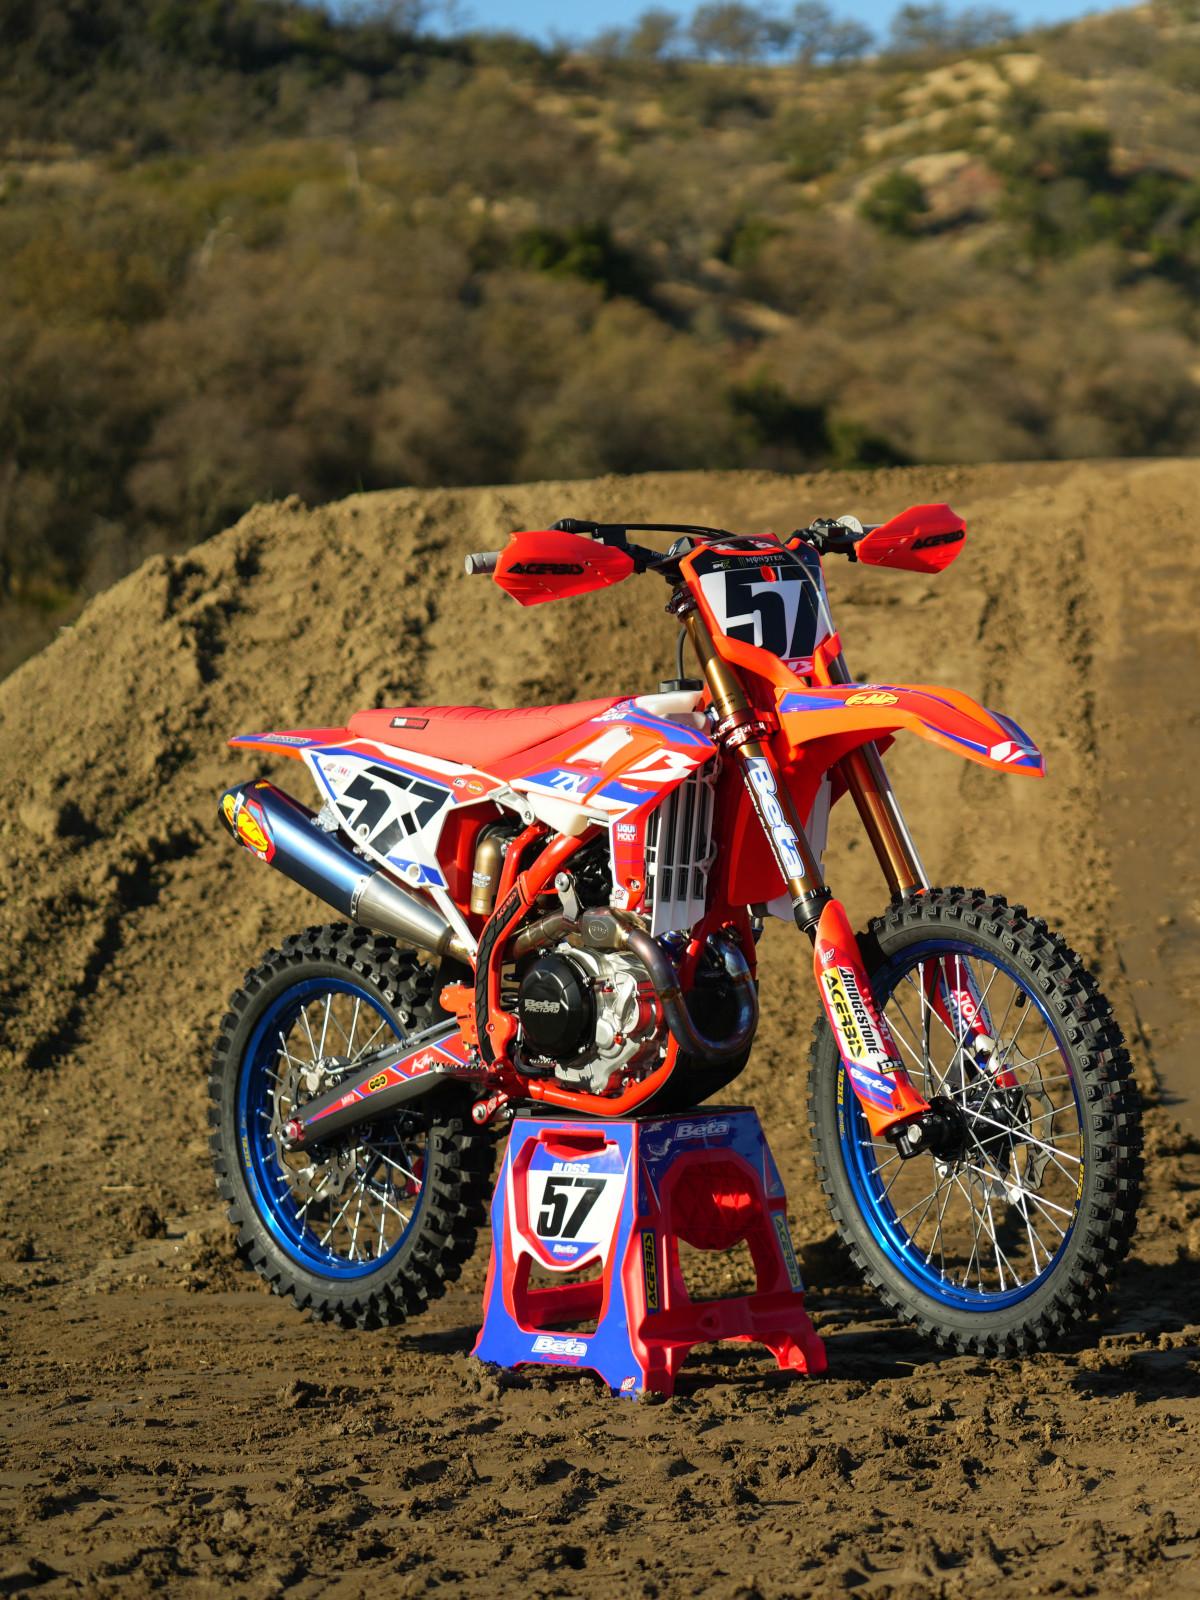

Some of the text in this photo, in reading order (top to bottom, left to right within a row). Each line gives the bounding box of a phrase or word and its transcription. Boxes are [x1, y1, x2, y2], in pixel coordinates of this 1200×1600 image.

[910, 528, 966, 552] ACERBIS
[505, 562, 586, 577] ACERBIS
[745, 554, 786, 564] MONSTER
[724, 565, 822, 660] 57
[844, 691, 899, 707] FMF
[335, 764, 454, 858] 57
[743, 757, 805, 879] Beta
[616, 824, 637, 833] LIQUI
[616, 832, 637, 842] MOLY
[524, 998, 561, 1009] Beta
[524, 1006, 561, 1014] FACTORY
[837, 965, 879, 1054] BRIDGESTONE
[954, 989, 982, 1028] MOLY
[824, 972, 863, 1060] ACERBIS
[878, 1011, 894, 1043] OLY
[850, 1067, 895, 1095] Beta
[673, 1118, 730, 1140] Beta
[551, 1162, 591, 1176] BLOSS
[536, 1176, 608, 1239] 57
[774, 1214, 799, 1288] ACERBIS
[646, 1231, 658, 1309] ACERBIS
[531, 1335, 588, 1357] Beta
[540, 1353, 580, 1364] racing
